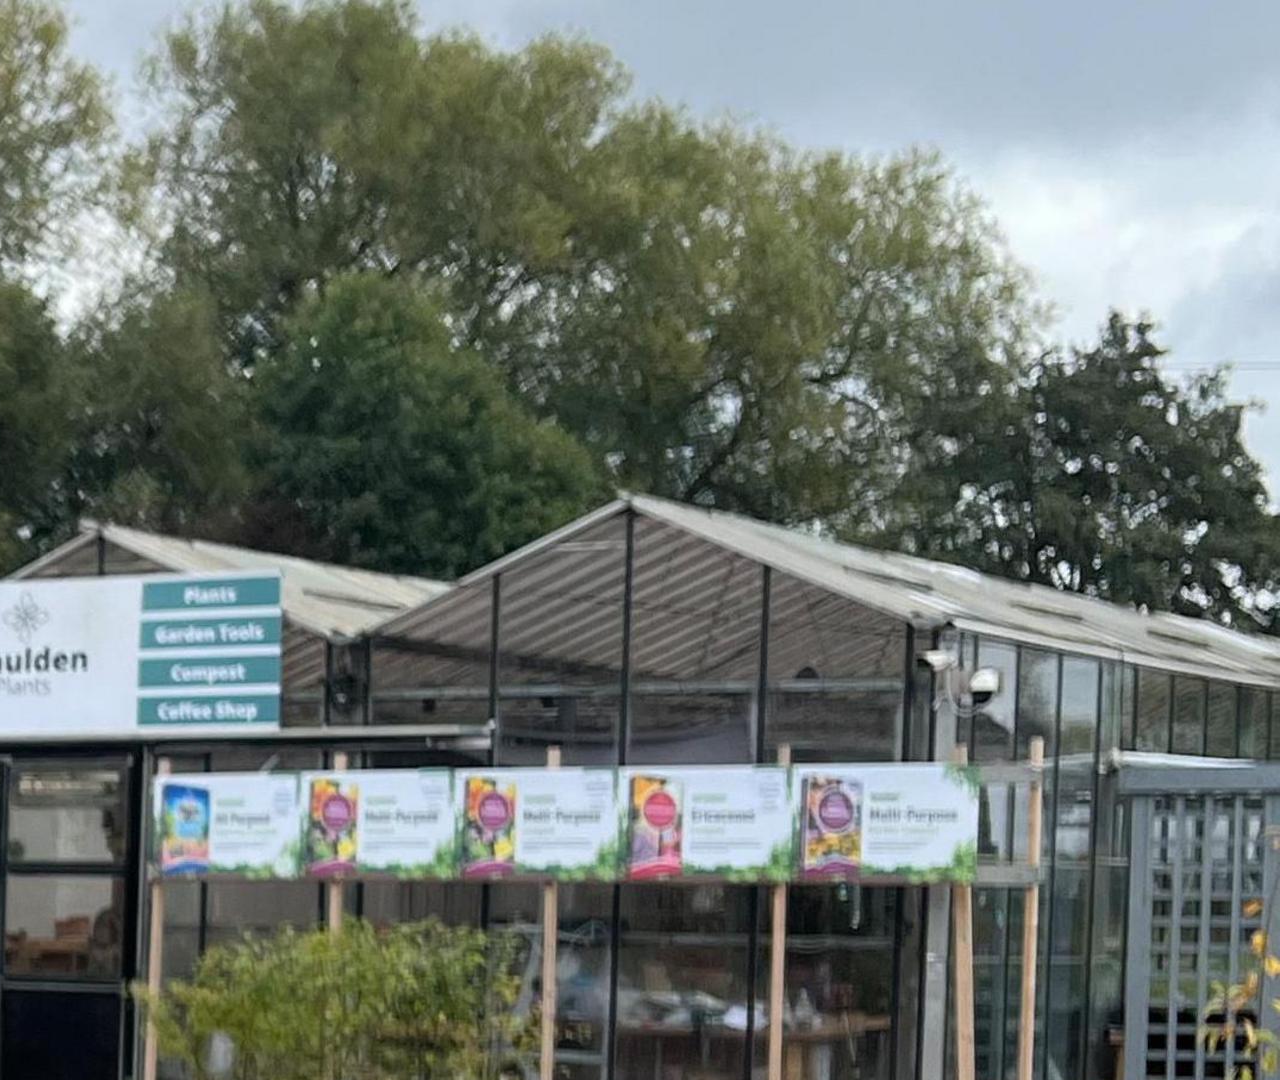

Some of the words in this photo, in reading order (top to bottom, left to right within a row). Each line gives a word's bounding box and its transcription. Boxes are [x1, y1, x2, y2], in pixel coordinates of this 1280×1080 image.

[183, 585, 237, 605] Plants
[154, 624, 216, 644] Garden
[219, 621, 265, 642] Tools
[170, 662, 246, 686] Compost
[157, 701, 212, 721] Coffee
[214, 700, 258, 723] Shop
